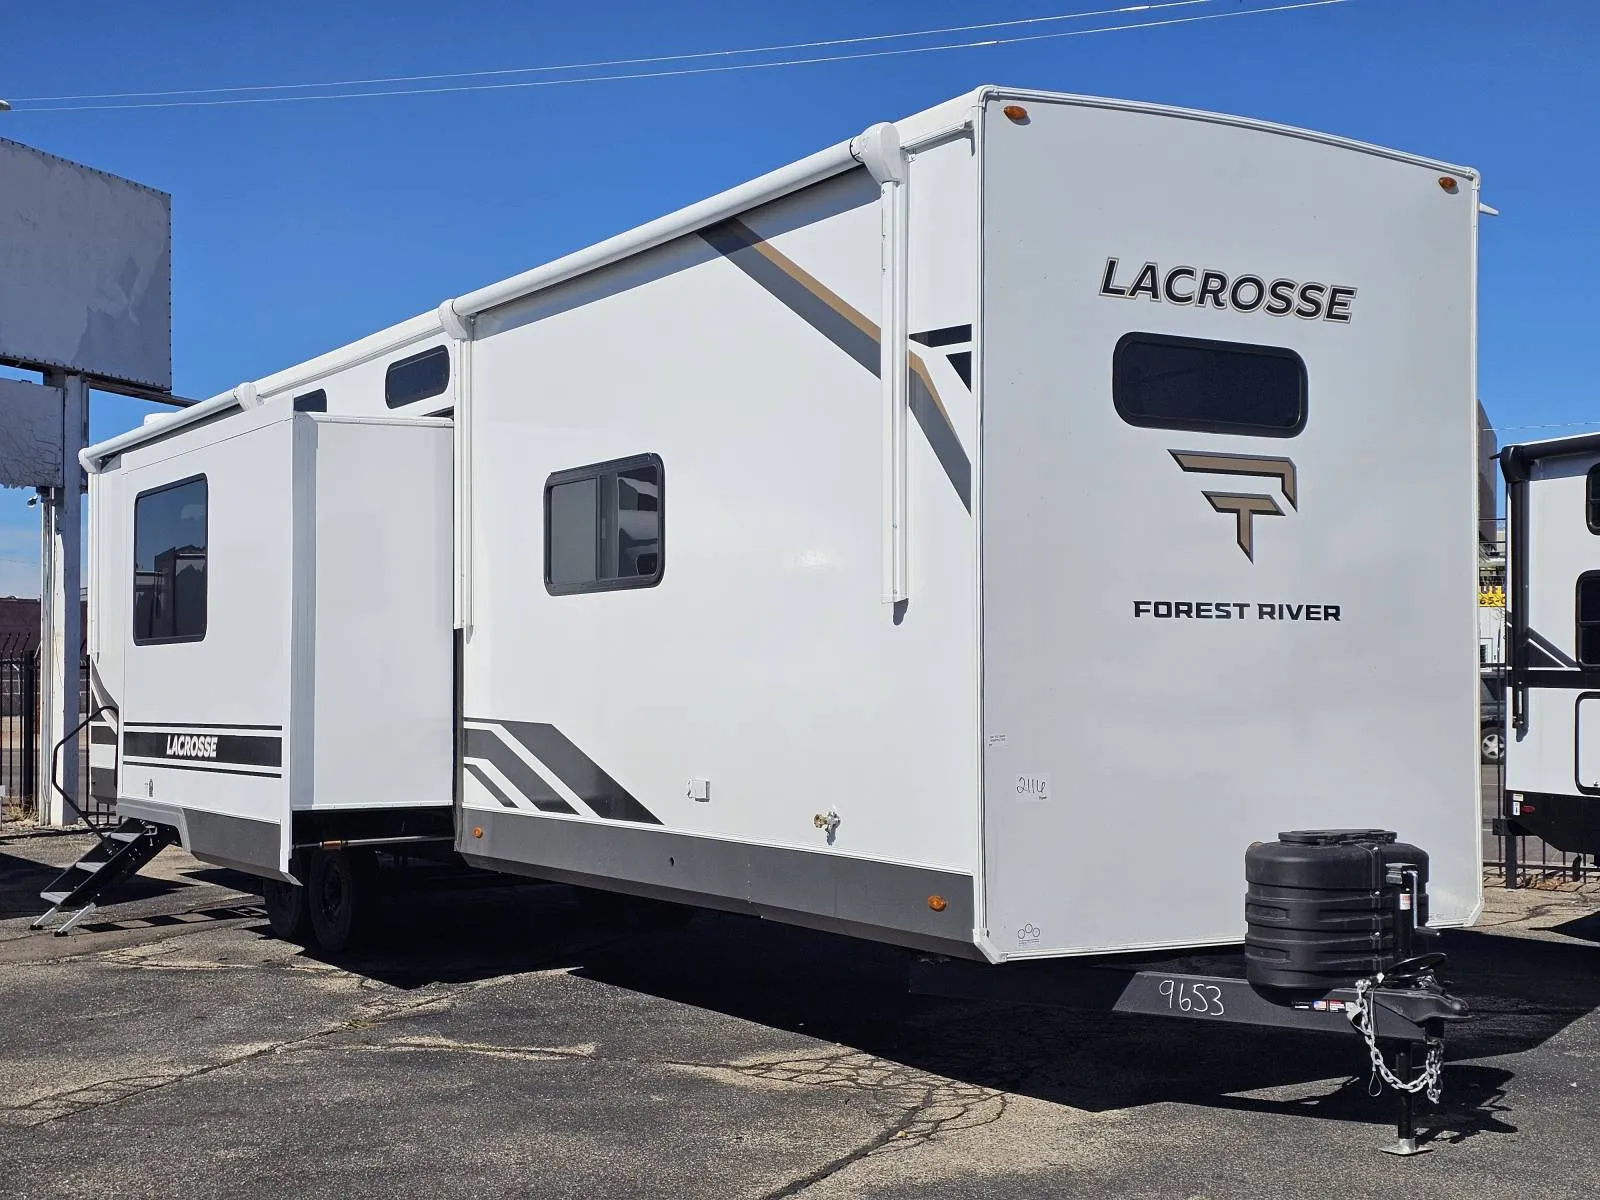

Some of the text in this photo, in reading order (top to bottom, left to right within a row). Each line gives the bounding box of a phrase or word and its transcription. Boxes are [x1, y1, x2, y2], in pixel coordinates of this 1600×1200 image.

[1099, 257, 1357, 323] LACROSSE
[1133, 600, 1341, 621] FOREST RIVER
[166, 735, 218, 758] LACROSSE
[1159, 980, 1224, 1016] 9653
